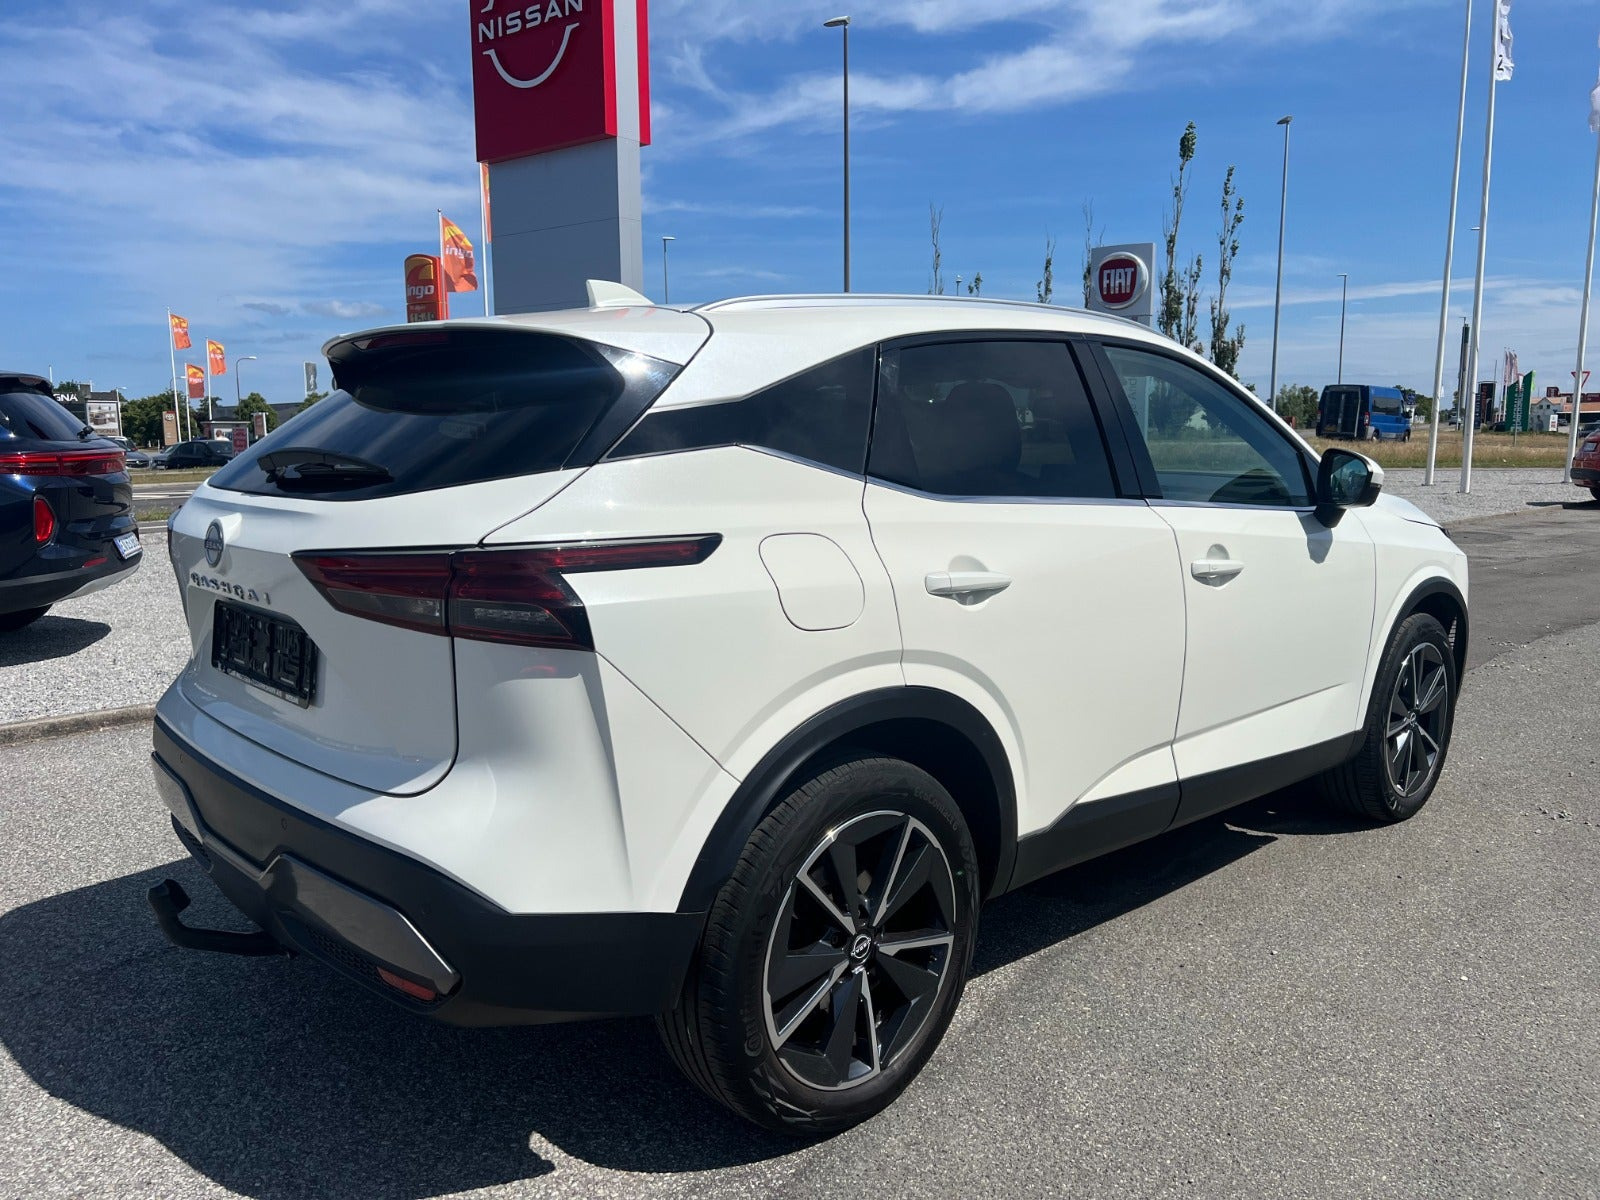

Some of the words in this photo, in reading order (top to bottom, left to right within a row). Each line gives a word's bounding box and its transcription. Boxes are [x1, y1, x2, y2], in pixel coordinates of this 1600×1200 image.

[478, 0, 583, 43] NISSAN
[445, 244, 473, 260] ingo
[407, 284, 434, 299] ingo
[1102, 268, 1134, 295] FIAT
